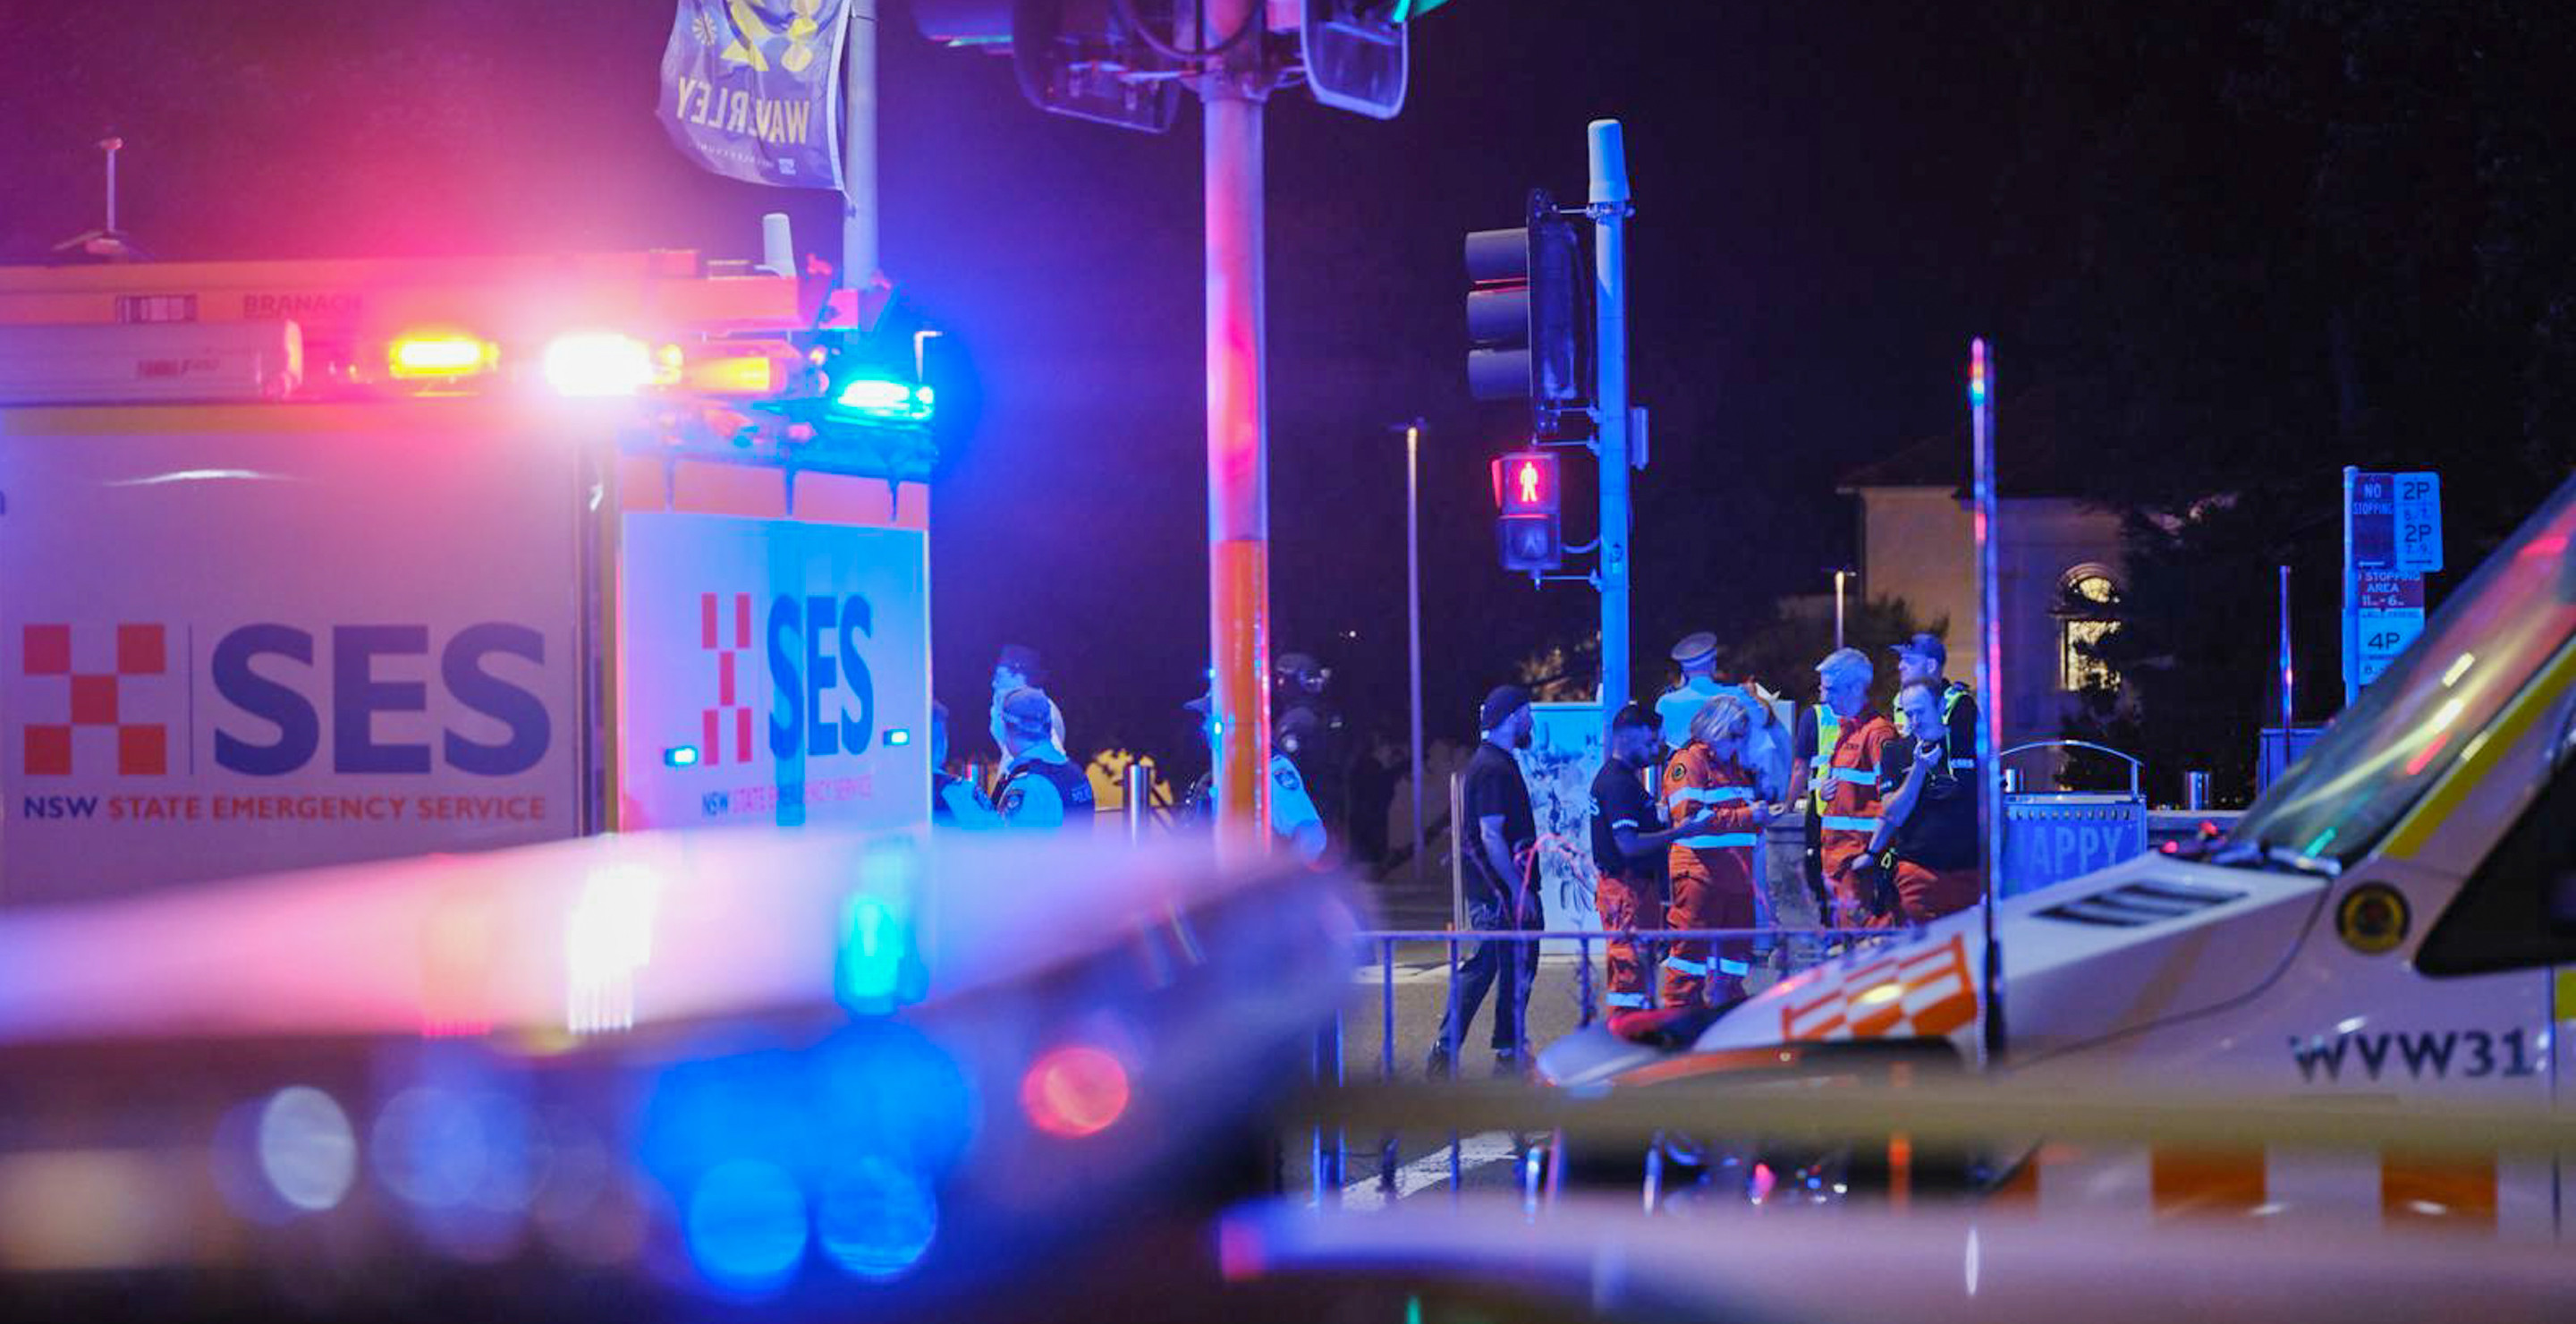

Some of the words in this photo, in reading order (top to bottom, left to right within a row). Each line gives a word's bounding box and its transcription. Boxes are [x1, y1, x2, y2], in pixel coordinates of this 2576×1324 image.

[2364, 484, 2382, 498] NO
[2403, 481, 2430, 500] 2P
[2353, 502, 2394, 514] STOPPING
[2405, 524, 2432, 543] 2P
[2368, 583, 2399, 592] AREA
[2368, 632, 2401, 650] 4P
[767, 593, 874, 760] SES
[212, 622, 552, 777] SES
[23, 796, 97, 819] NSW
[108, 796, 199, 820] STATE
[213, 796, 406, 820] EMERGENCY
[417, 796, 546, 820] SERVICE
[2289, 1028, 2535, 1082] WVW31
